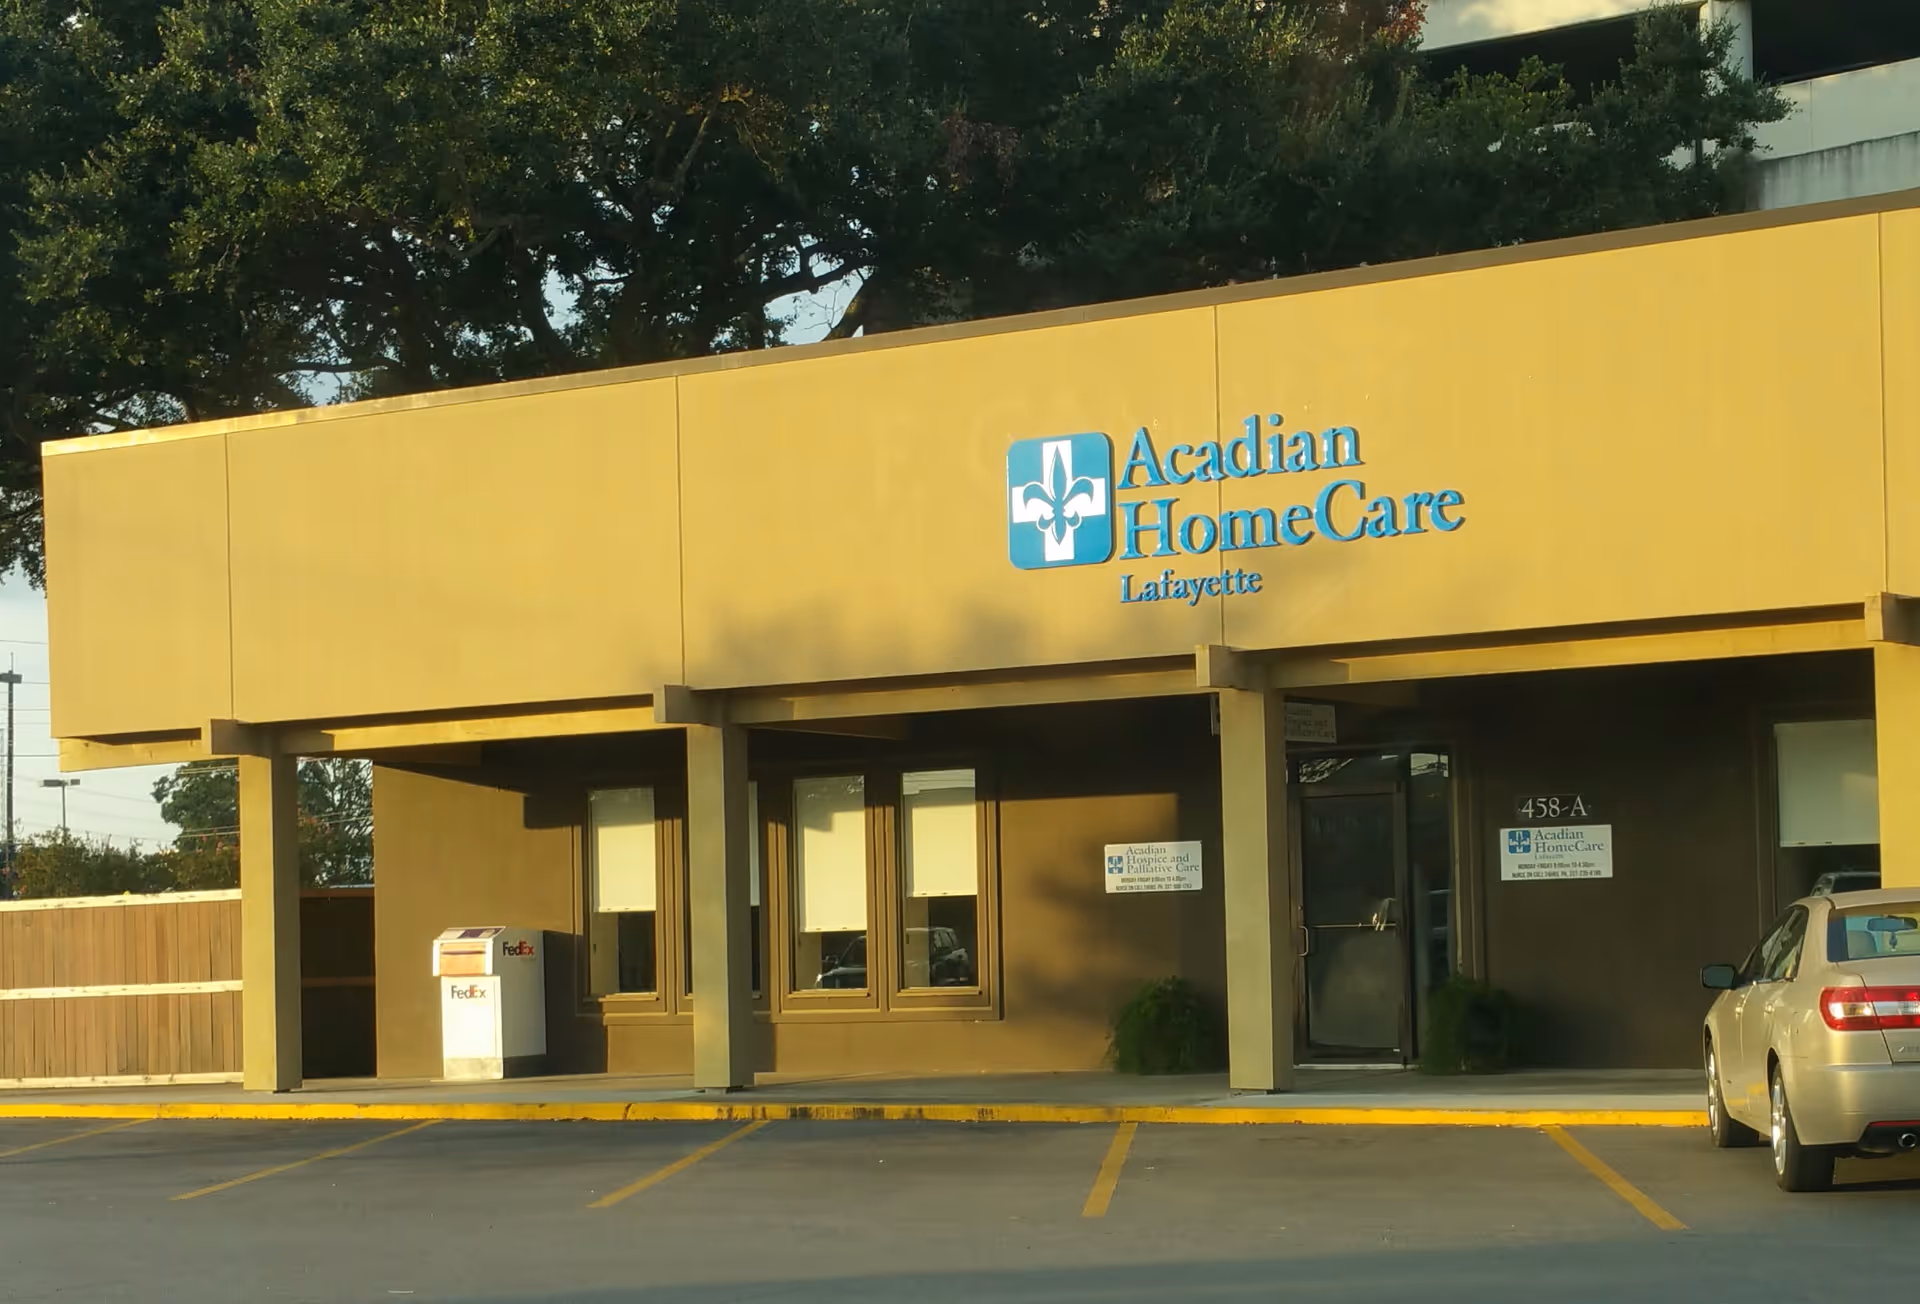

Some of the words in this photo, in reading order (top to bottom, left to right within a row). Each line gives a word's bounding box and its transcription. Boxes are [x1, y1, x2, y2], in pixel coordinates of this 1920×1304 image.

[1117, 413, 1364, 489] Acadian
[1118, 480, 1465, 560] HomeCare
[1120, 566, 1262, 607] Lafayette
[1521, 795, 1588, 818] 458-A
[1534, 828, 1584, 841] Acadian
[1126, 845, 1167, 856] Acadian
[1535, 840, 1605, 853] HomeCare
[1126, 854, 1168, 866] Hospice
[1170, 853, 1189, 863] and
[1127, 864, 1173, 874] Palliative
[1175, 863, 1200, 872] Care
[502, 940, 535, 956] FedEx
[450, 984, 487, 999] FedEx
